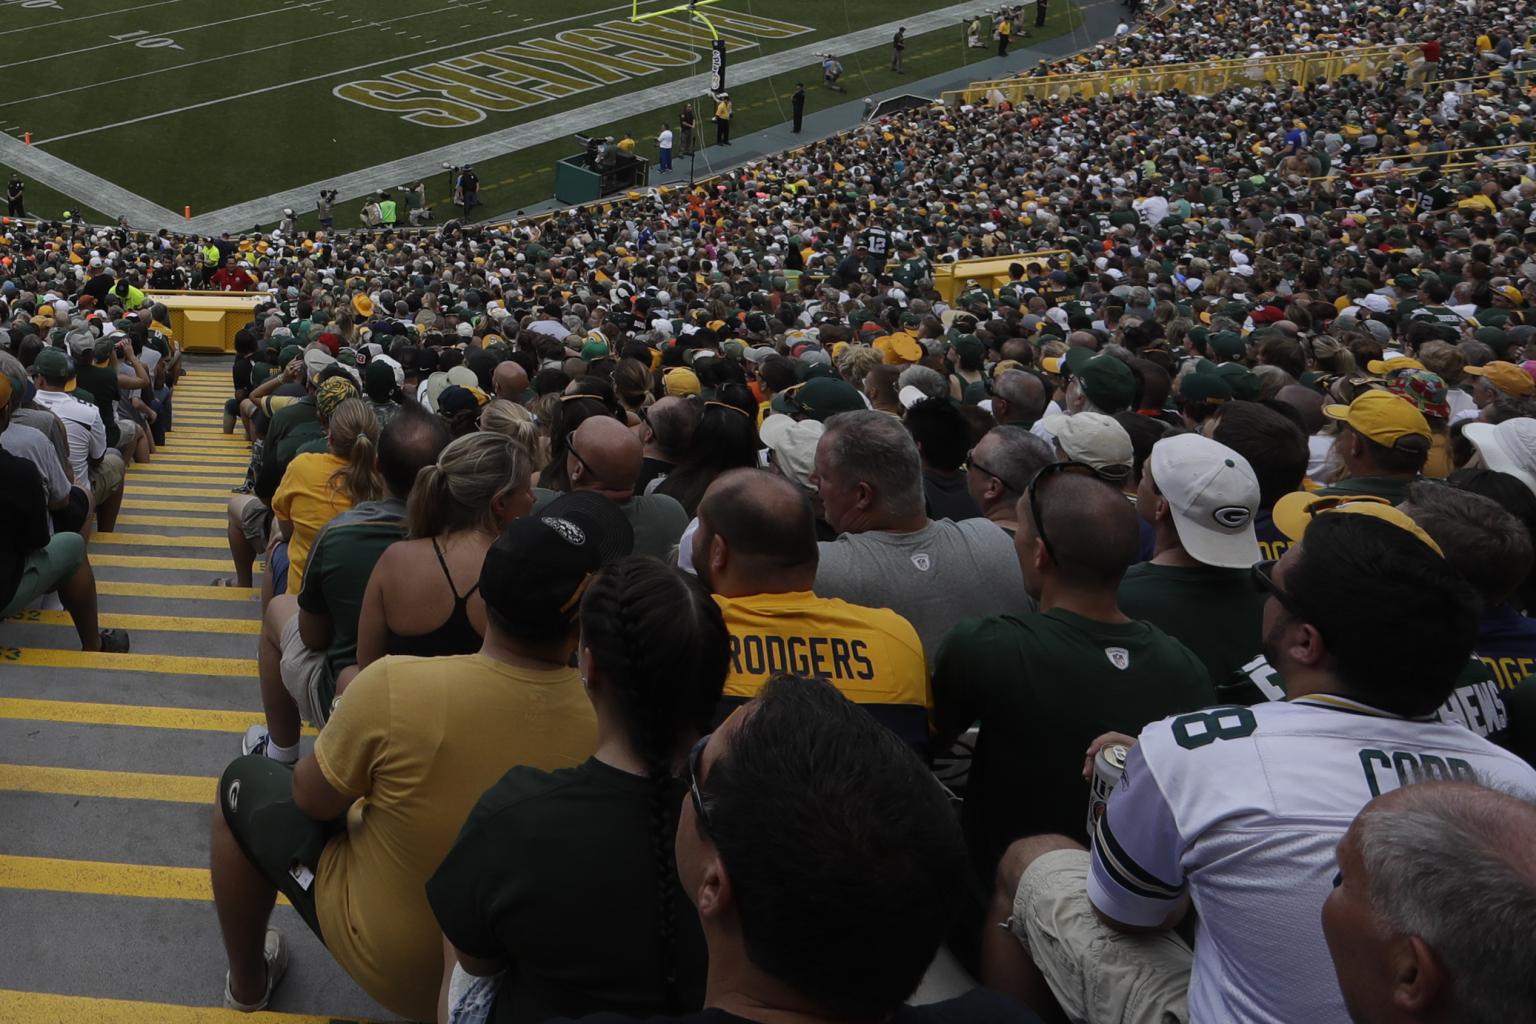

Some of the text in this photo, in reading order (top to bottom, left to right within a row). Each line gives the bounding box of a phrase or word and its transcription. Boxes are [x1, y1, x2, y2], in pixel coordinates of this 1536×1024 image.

[109, 29, 176, 49] 10
[332, 5, 817, 128] PACKERS
[867, 235, 886, 254] 12
[1214, 506, 1249, 527] G
[727, 633, 876, 681] RODGERS
